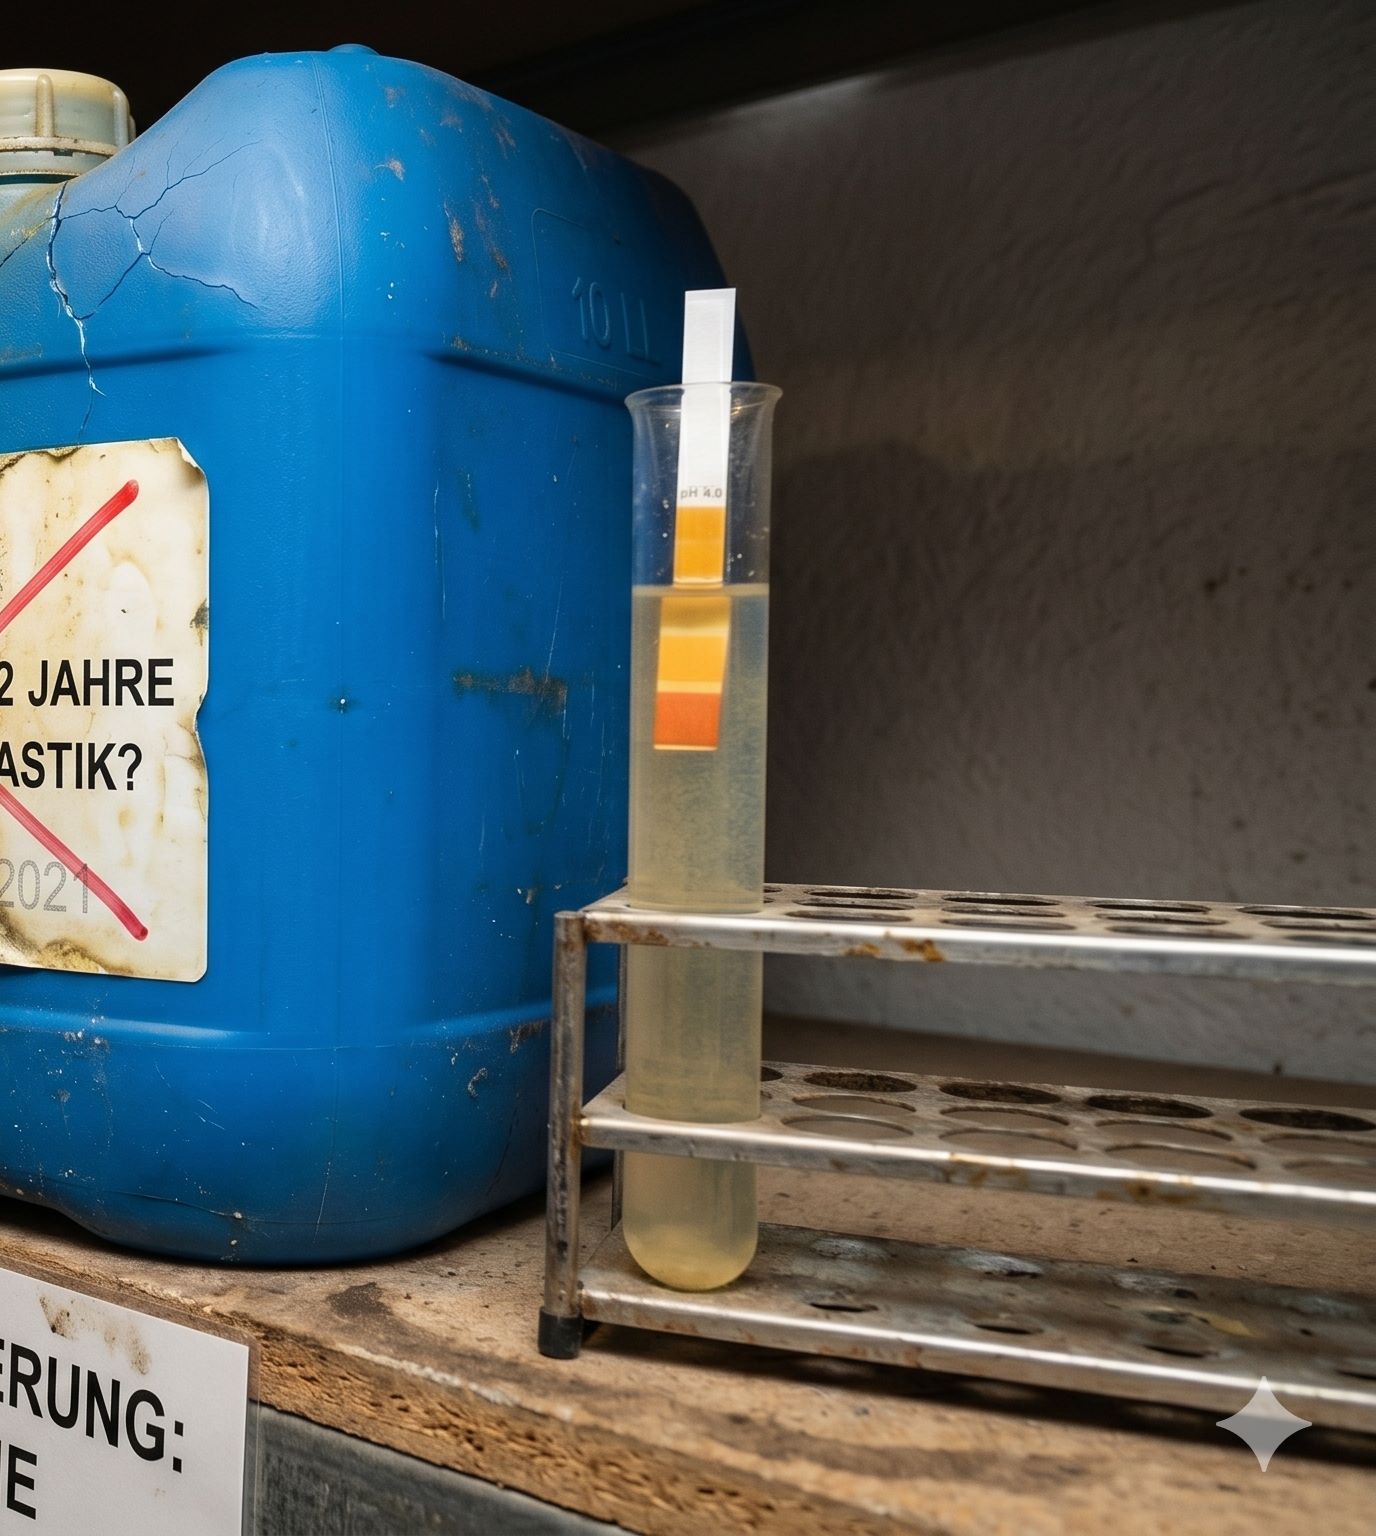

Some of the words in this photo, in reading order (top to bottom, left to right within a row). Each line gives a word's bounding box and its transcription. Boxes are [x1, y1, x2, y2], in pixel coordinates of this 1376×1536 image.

[680, 486, 698, 499] pH
[703, 487, 722, 498] 4.0
[28, 658, 175, 708] JAHRE
